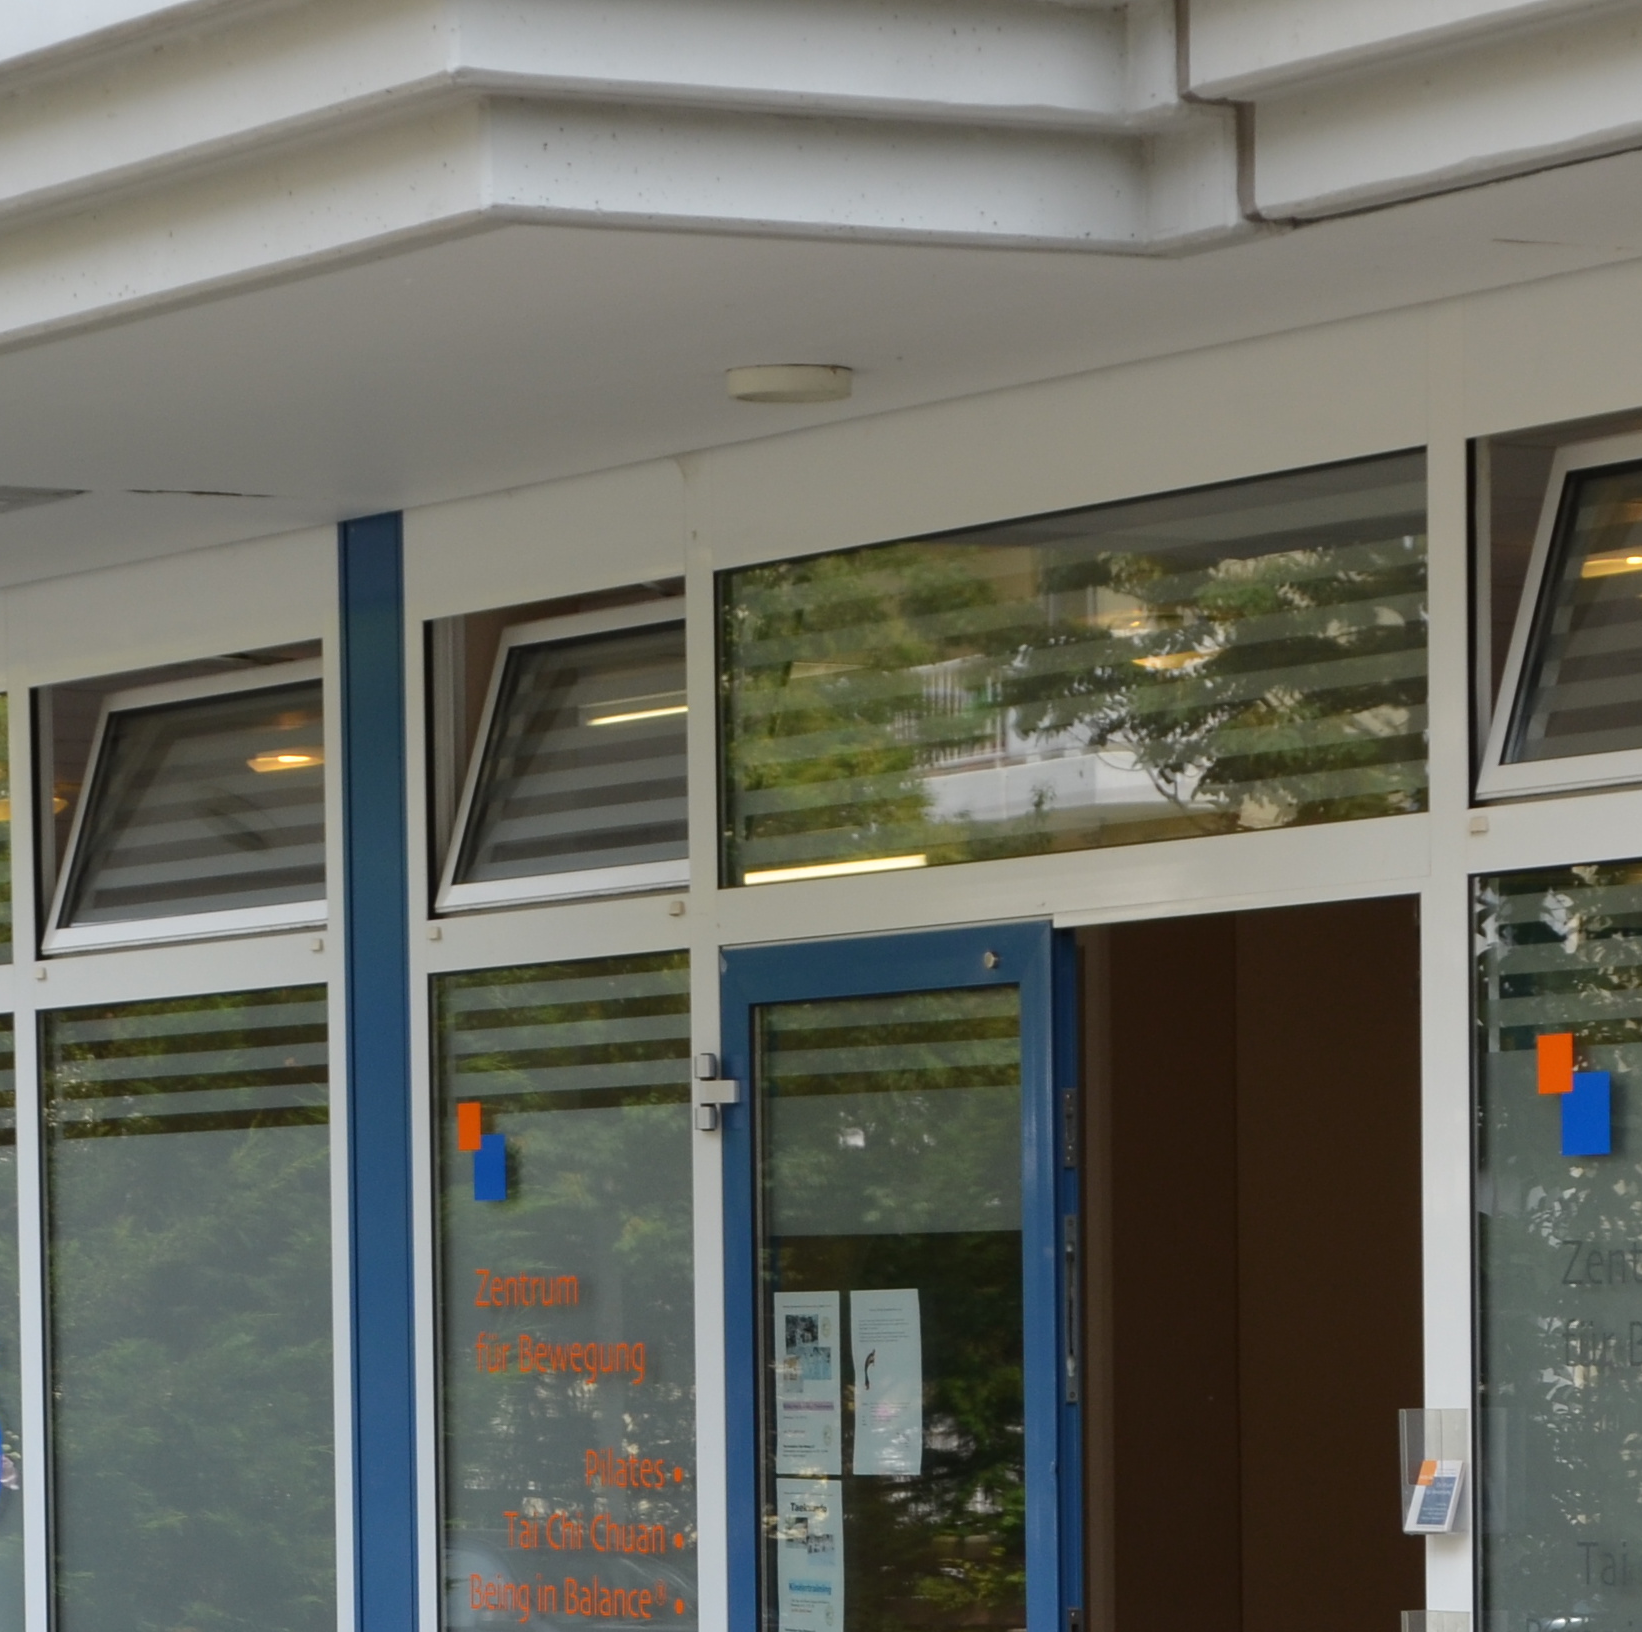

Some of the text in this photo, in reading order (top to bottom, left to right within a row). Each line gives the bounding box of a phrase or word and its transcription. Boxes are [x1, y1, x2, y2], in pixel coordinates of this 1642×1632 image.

[474, 1268, 580, 1308] Zentrum
[475, 1331, 646, 1386] für Bewegung
[585, 1448, 666, 1489] Pilates
[502, 1511, 667, 1554] Tai Chi Chuan
[1576, 1540, 1628, 1587] Tai
[469, 1573, 531, 1623] Being
[536, 1573, 557, 1613] in
